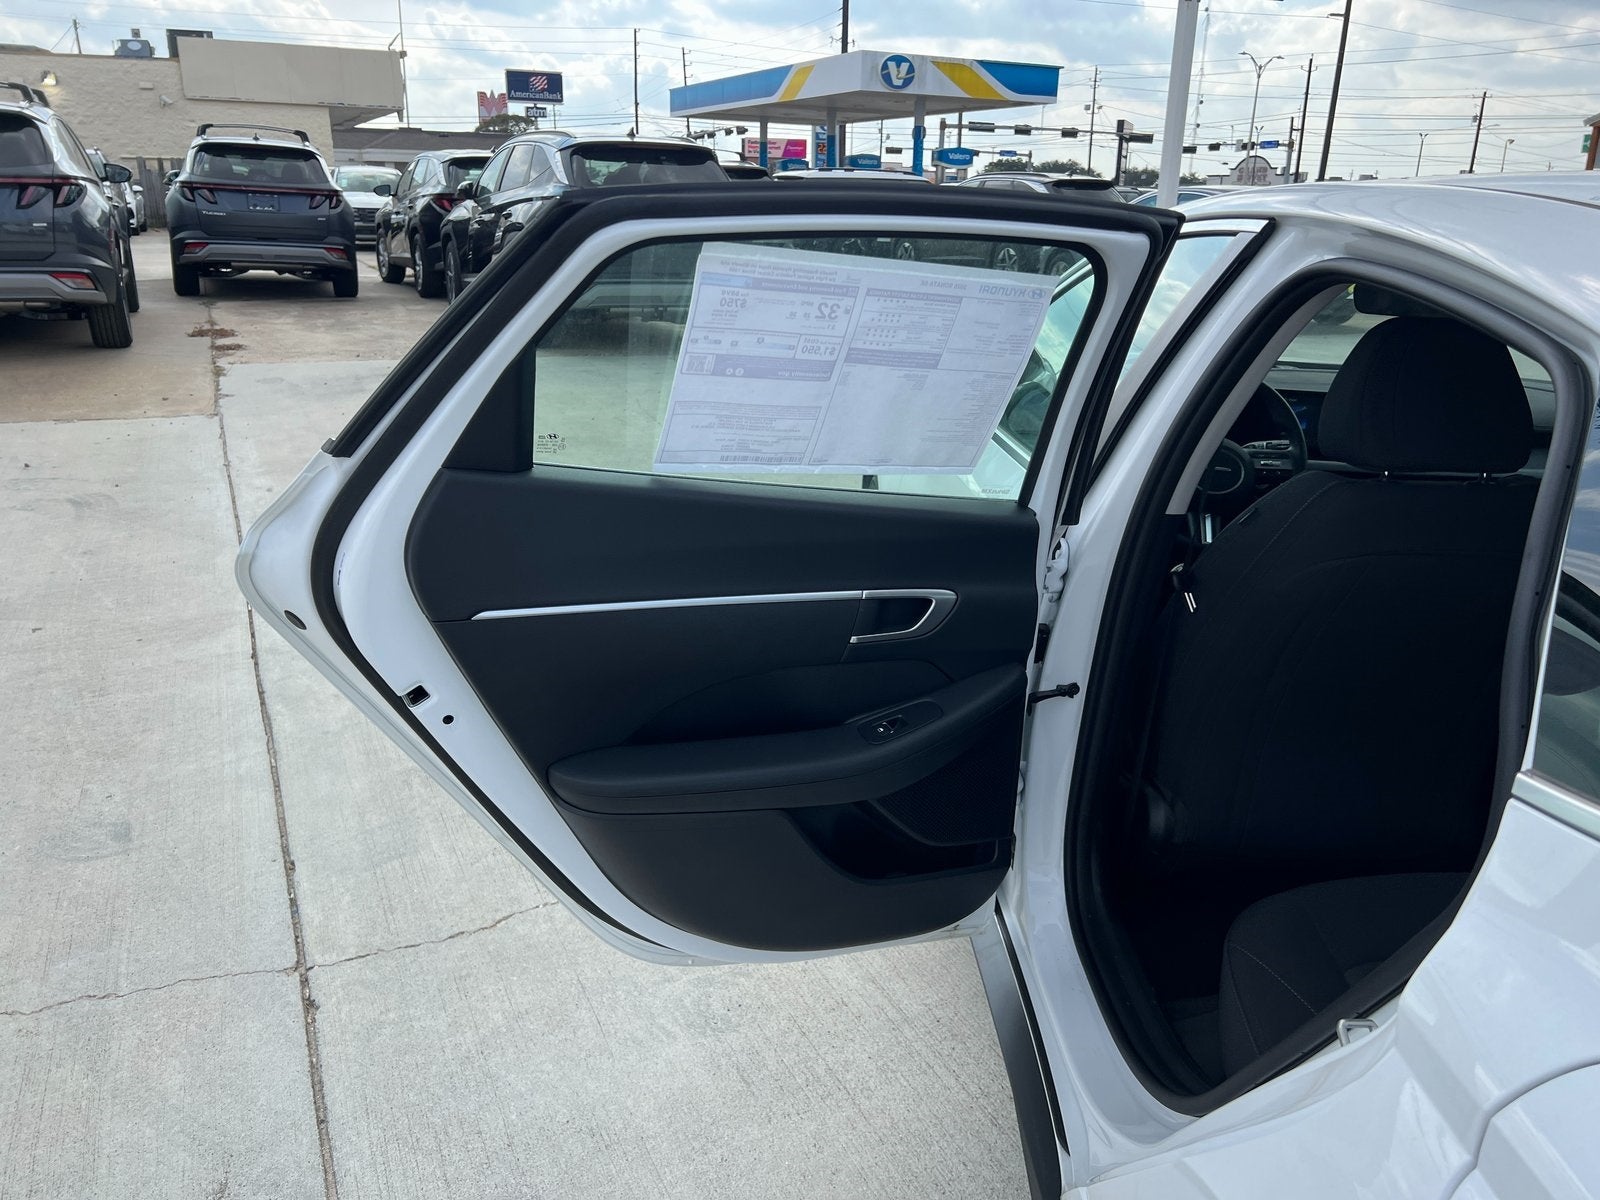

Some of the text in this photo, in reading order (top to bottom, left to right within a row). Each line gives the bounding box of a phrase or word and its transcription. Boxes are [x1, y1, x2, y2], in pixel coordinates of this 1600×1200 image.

[510, 90, 562, 100] AmericanBank
[527, 108, 547, 117] atm
[948, 152, 970, 160] Valero
